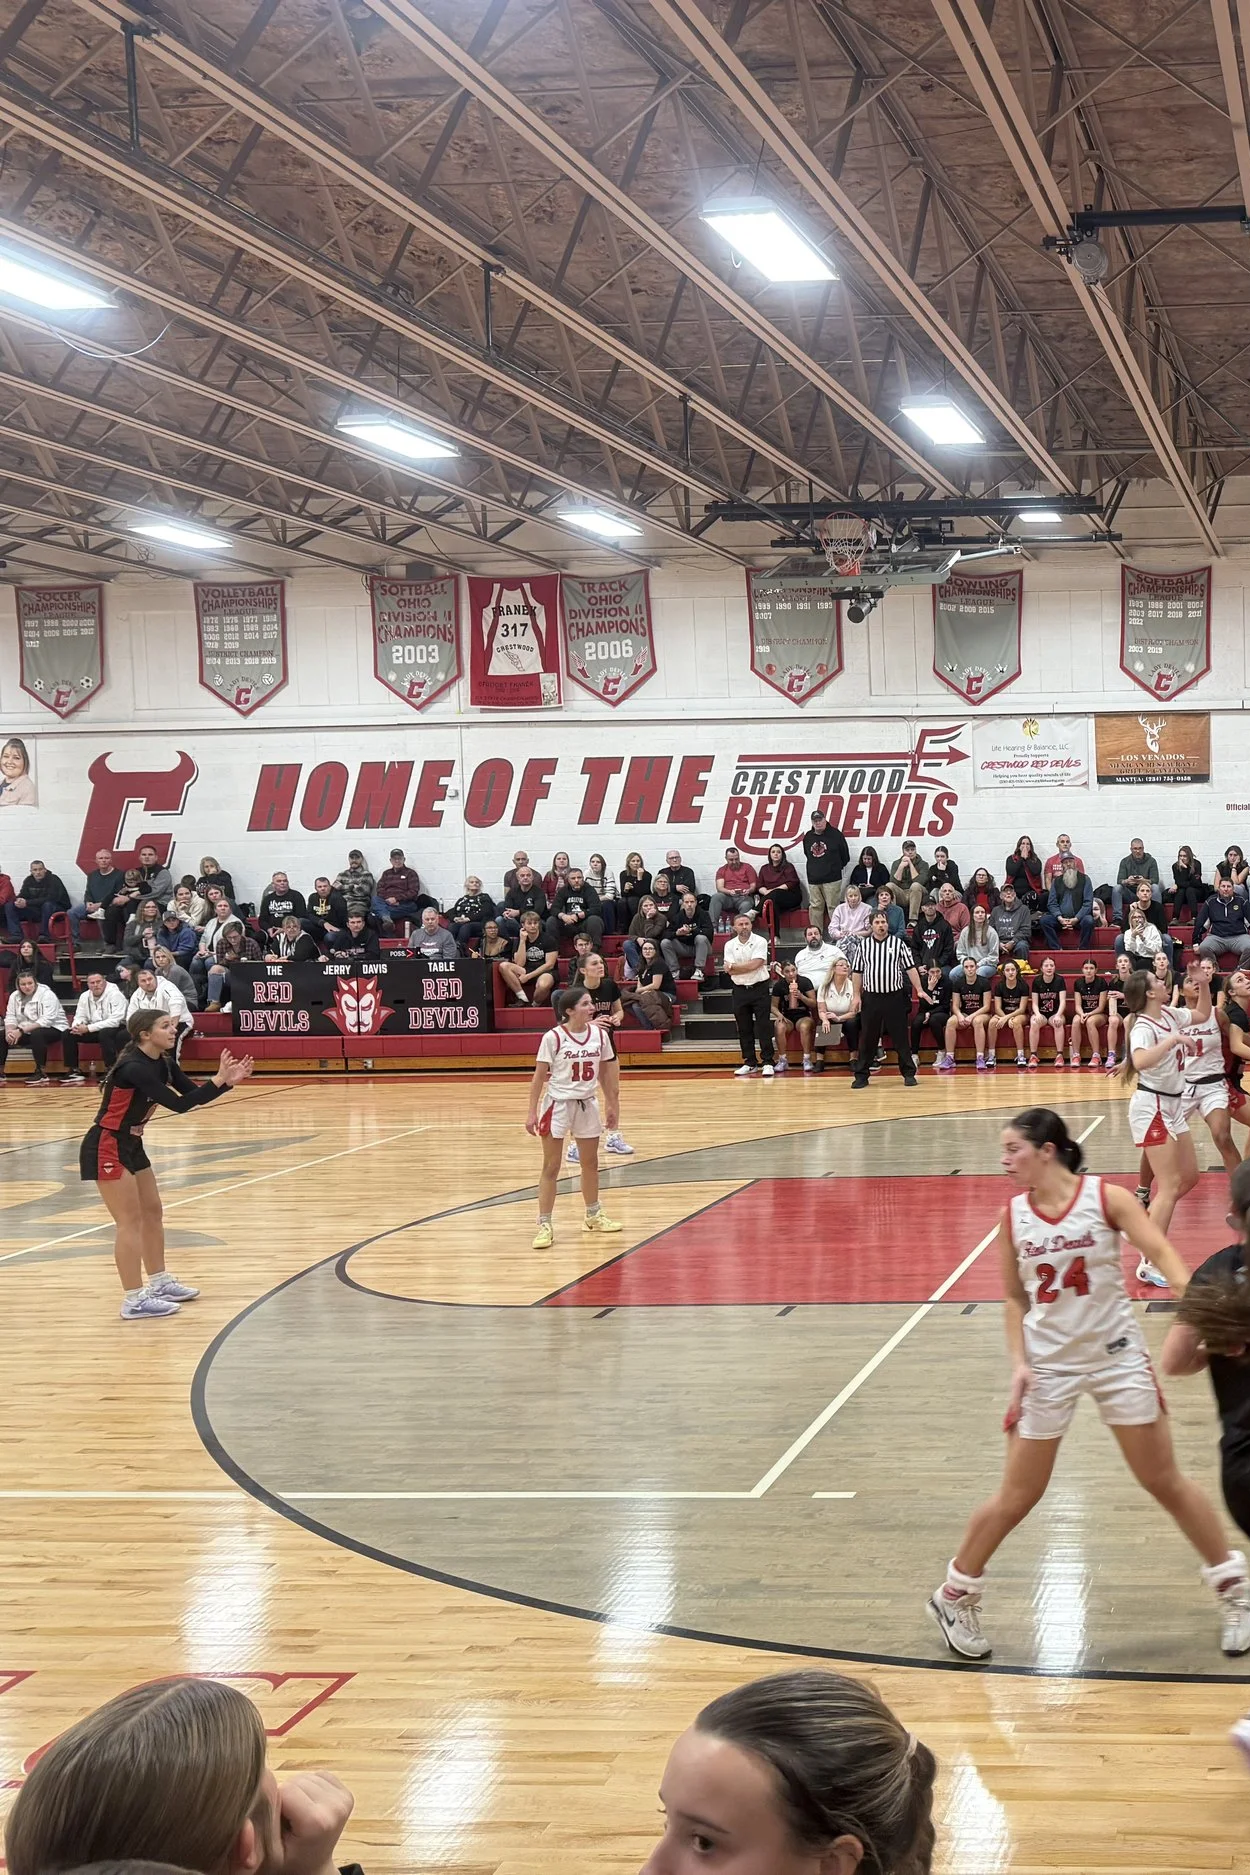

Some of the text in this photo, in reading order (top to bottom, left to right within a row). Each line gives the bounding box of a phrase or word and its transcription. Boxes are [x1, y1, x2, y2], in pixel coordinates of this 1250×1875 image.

[579, 580, 629, 594] TRACK
[946, 578, 1009, 590] BOWLING
[1136, 574, 1196, 586] SOFTBALL
[35, 591, 82, 602] SOCCER
[201, 586, 277, 599] VOLLEYBALL
[380, 583, 447, 596] SOFTBALL
[938, 585, 1016, 602] CHAMPIONSHIPS
[1128, 582, 1205, 599] CHAMPIONSHIPS
[1148, 593, 1184, 601] LEAGUE
[201, 597, 278, 613] CHAMPIONSHIPS
[396, 597, 431, 609] OHIO
[588, 594, 623, 606] OHIO
[960, 597, 995, 606] LEAGUE
[23, 601, 97, 617] CHAMPIONSHIPS
[378, 611, 437, 622] DIVISION
[491, 604, 537, 617] FRANEK
[569, 605, 630, 620] DIVISION
[978, 606, 995, 614] 2015
[378, 624, 454, 644] CHAMPIONS
[501, 623, 529, 638] 317
[568, 616, 647, 642] CHAMPIONS
[392, 645, 440, 664] 2003
[496, 643, 534, 653] CRESTWOOD
[584, 638, 634, 661] 2006
[595, 668, 608, 683] LADY
[960, 666, 973, 681] LADY
[1148, 664, 1162, 678] LADY
[407, 679, 426, 699] C
[602, 675, 621, 696] C
[787, 672, 807, 693] C
[966, 673, 984, 695] C
[1154, 671, 1174, 692] C
[53, 687, 72, 708] C
[235, 686, 253, 706] C
[1003, 743, 1026, 753] Hearing
[1033, 743, 1058, 751] Balance,
[980, 756, 1082, 772] CRESTWOOD RED DEVILS
[1109, 761, 1144, 769] MEXICAN
[1120, 753, 1185, 762] LOS VENADOS
[730, 768, 905, 796] CRESTWOOD
[246, 754, 716, 833] HOME OF THE
[1225, 803, 1250, 811] Official
[719, 792, 959, 855] RED DEVILS
[389, 949, 407, 958] POSS.
[266, 961, 456, 976] THE JERRY DAVIS TABLE
[253, 981, 293, 1004] RED
[421, 977, 464, 1001] RED
[239, 1009, 311, 1032] DEVILS
[408, 1006, 480, 1030] DEVILS
[563, 1047, 601, 1060] Red Devils
[571, 1060, 595, 1082] 15
[1036, 1255, 1091, 1305] 24
